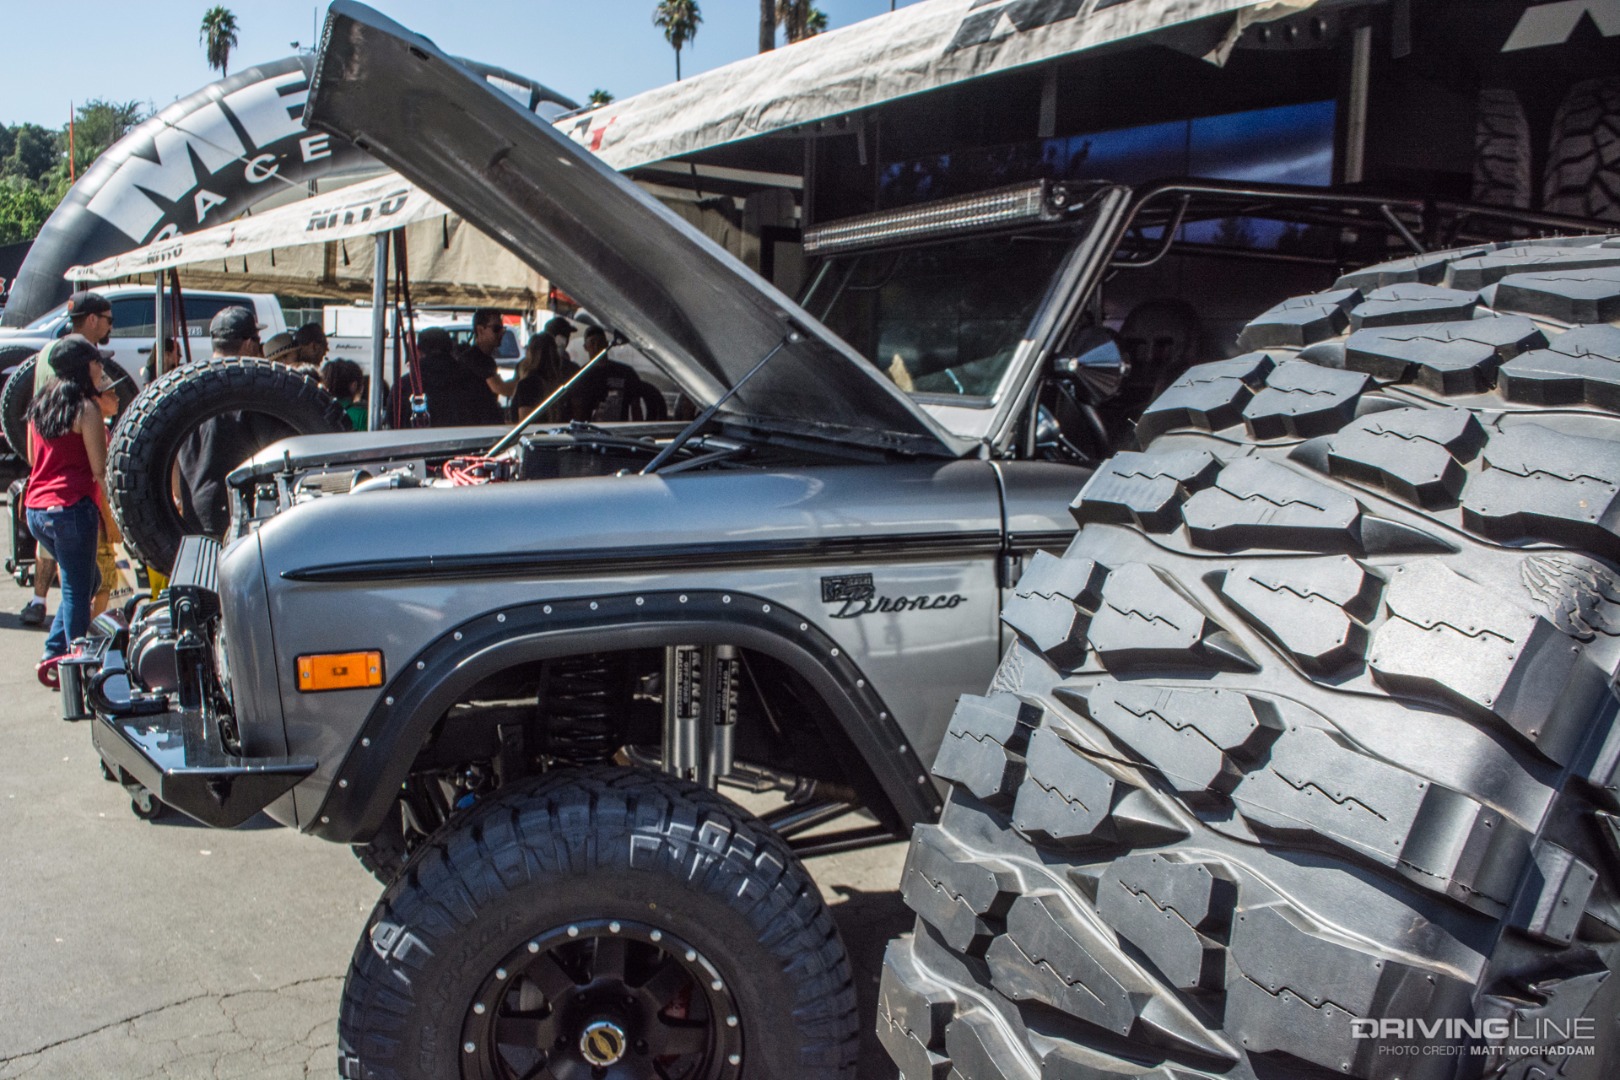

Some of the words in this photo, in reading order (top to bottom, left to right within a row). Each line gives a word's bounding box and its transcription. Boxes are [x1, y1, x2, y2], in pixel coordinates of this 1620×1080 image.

[305, 188, 409, 232] NITTO
[829, 584, 968, 619] Bronco
[691, 651, 701, 717] KING
